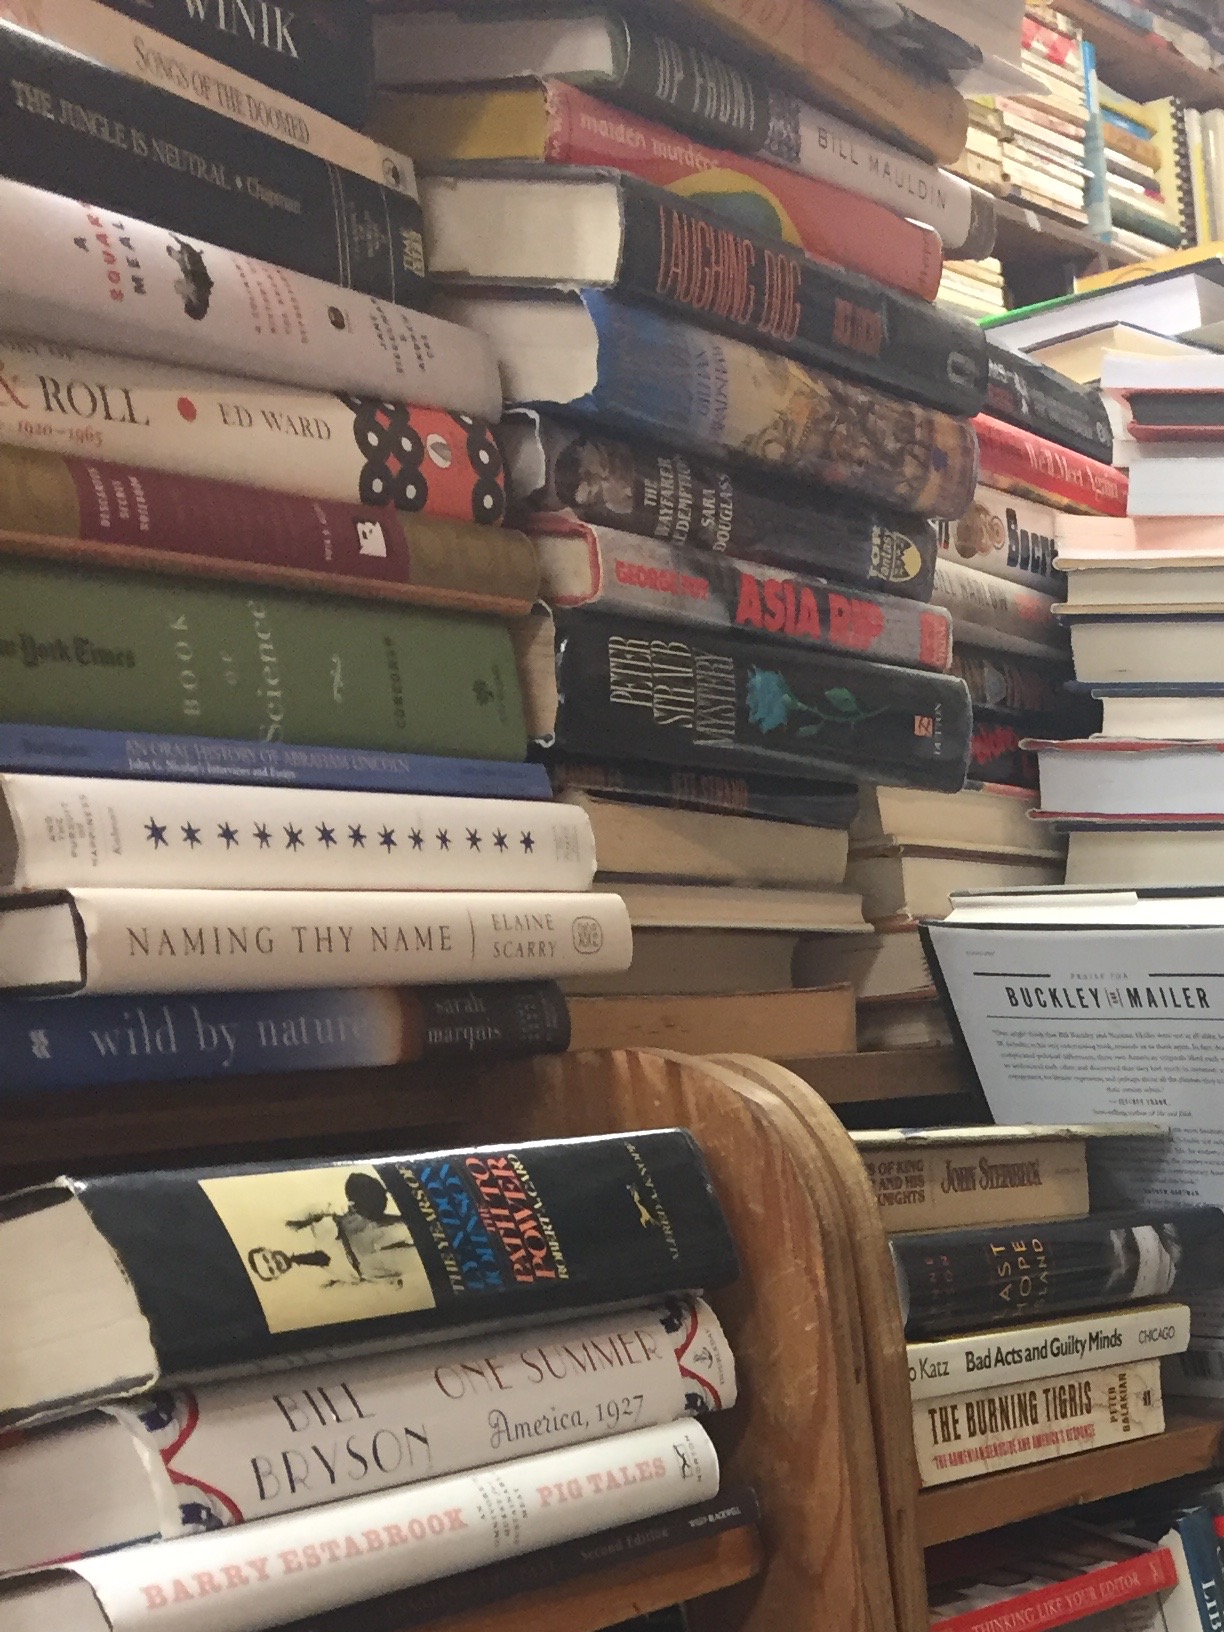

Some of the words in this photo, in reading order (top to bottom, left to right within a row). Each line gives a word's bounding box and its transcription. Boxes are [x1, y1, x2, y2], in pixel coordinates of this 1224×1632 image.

[132, 35, 189, 90] SONGS
[192, 70, 209, 98] OF
[216, 80, 246, 117] THE
[248, 93, 310, 145] DOOMED
[11, 79, 54, 120] THE
[58, 99, 127, 149] JUNGLE
[131, 128, 148, 157] IS
[151, 138, 231, 190] NEUTRAL
[817, 127, 860, 166] BILL
[869, 154, 947, 210] MAULDIN
[38, 374, 150, 426] ROLL
[217, 402, 252, 428] ED
[262, 409, 331, 441] WARD
[735, 573, 821, 639] ASIA
[608, 635, 652, 706] PETER
[127, 924, 274, 958] NAMING
[291, 925, 355, 954] THY
[370, 925, 454, 954] NAME
[493, 914, 556, 933] ELAINE
[493, 939, 557, 959] SCARRY
[1006, 986, 1102, 1008] BUCKLEY
[1126, 988, 1211, 1008] MAILER
[90, 1010, 178, 1060] wild
[199, 1005, 240, 1067] by
[258, 1008, 367, 1049] nature
[427, 1023, 501, 1051] marquis
[432, 1361, 504, 1399] ONE
[525, 1328, 664, 1384] SUMMER
[920, 1359, 949, 1379] Katz
[965, 1349, 992, 1372] Bad
[994, 1345, 1023, 1367] Acts
[1025, 1342, 1048, 1360] and
[1050, 1337, 1086, 1361] Guilty
[1088, 1329, 1122, 1351] Minds
[1138, 1327, 1175, 1344] CHICAGO
[272, 1380, 376, 1434] BILL
[486, 1408, 591, 1450] America,
[595, 1395, 647, 1428] 1927
[929, 1403, 961, 1444] THE
[967, 1388, 1039, 1437] BURNING
[1043, 1381, 1092, 1421] TIGRIS
[250, 1425, 432, 1502] BRYSON
[141, 1558, 269, 1611] BARRY
[281, 1509, 469, 1573] ESTABROOK
[536, 1478, 586, 1509] PIG
[591, 1456, 669, 1495] TALES
[1037, 1597, 1063, 1619] LIKE
[1099, 1572, 1141, 1600] EDITOR
